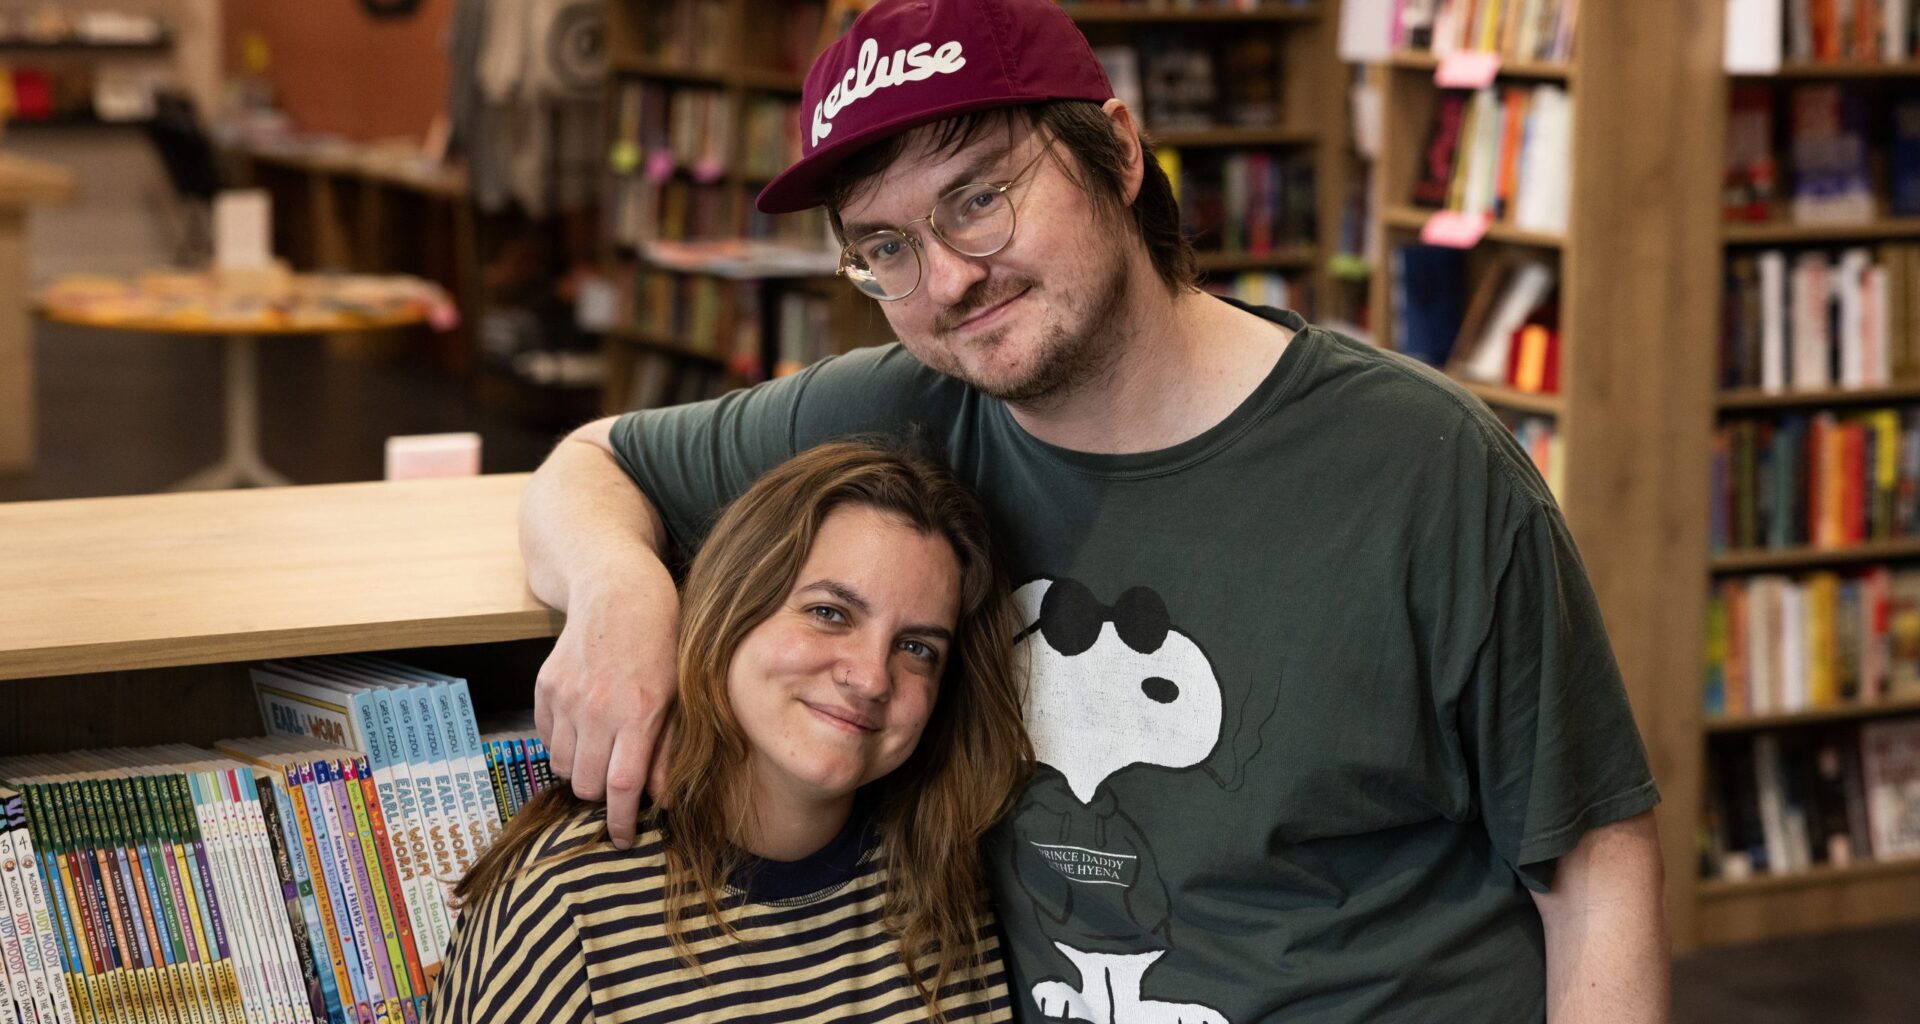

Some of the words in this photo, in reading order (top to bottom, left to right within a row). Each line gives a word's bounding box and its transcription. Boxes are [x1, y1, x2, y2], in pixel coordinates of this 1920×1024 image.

[811, 37, 967, 148] Recluse
[438, 695, 451, 718] GREG
[456, 692, 470, 716] GREG
[463, 719, 479, 749] PIZZOLI
[270, 702, 304, 736] EARL
[307, 713, 347, 748] WORM
[361, 704, 373, 728] GREG
[368, 731, 382, 762] PIZZOLI
[378, 699, 391, 723] GREG
[385, 727, 400, 757] PIZZOLI
[398, 699, 411, 723] GREG
[405, 726, 420, 757] PIZZOLI
[417, 697, 431, 721] GREG
[424, 724, 440, 755] PIZZOLI
[444, 721, 460, 752] PIZZOLI
[320, 773, 325, 782] 3
[455, 771, 477, 812] EARL
[473, 769, 495, 809] EARL
[378, 782, 399, 822] EARL
[391, 831, 414, 880] WORM
[395, 777, 417, 817] EARL
[408, 826, 431, 875] WORM
[416, 776, 438, 816] EARL
[429, 825, 452, 874] WORM
[435, 774, 456, 814] EARL
[448, 823, 471, 872] WORM
[0, 840, 10, 854] 3
[19, 836, 28, 850] 4
[306, 844, 318, 870] AMELIA
[320, 841, 331, 866] AMELIA
[333, 834, 345, 858] Amelia
[277, 855, 291, 881] Wrenly
[293, 852, 306, 878] Wrenly
[339, 859, 352, 883] Bedelia
[1077, 864, 1120, 880] HYENA
[1082, 853, 1124, 870] DADDY
[8, 876, 23, 907] McDONALD
[27, 873, 41, 904] McDONALD
[146, 868, 154, 888] GHOST
[151, 890, 159, 908] TOWN
[407, 886, 418, 904] The
[423, 881, 436, 900] The
[34, 908, 50, 932] JUDY
[75, 877, 86, 905] MUMMIES
[89, 931, 99, 961] MORNING
[88, 885, 97, 909] PIRATES
[98, 928, 106, 947] NOON
[95, 879, 103, 898] NIGHT
[101, 900, 106, 908] OF
[106, 924, 115, 947] NINJAS
[113, 871, 122, 893] SUNSET
[119, 896, 124, 904] OF
[125, 920, 138, 958] SABERTOOTH
[159, 876, 167, 895] LIONS
[167, 907, 178, 940] LUNCHTIME
[170, 865, 178, 885] POLAR
[175, 887, 183, 906] BEARS
[184, 925, 194, 950] BEDTIME
[201, 865, 209, 887] VIKING
[214, 919, 223, 944] SUNRISE
[348, 893, 362, 926] FRIENDS
[412, 906, 424, 927] Bad
[429, 902, 442, 923] Bad
[0, 915, 14, 939] JUDY
[15, 911, 32, 936] JUDY
[357, 930, 367, 946] Arise
[435, 924, 448, 947] Idea
[22, 936, 41, 971] MOODY
[40, 933, 58, 968] MOODY
[294, 921, 303, 934] The
[303, 960, 315, 985] Dragon
[361, 947, 370, 960] and
[418, 929, 431, 952] Idea
[5, 939, 23, 975] MOODY
[364, 961, 376, 980] Shine
[1, 998, 10, 1007] IN
[16, 980, 27, 996] GETS
[33, 977, 45, 996] SAVES
[39, 999, 48, 1010] THE
[52, 973, 64, 998] PREDICTS
[59, 1000, 68, 1011] THE
